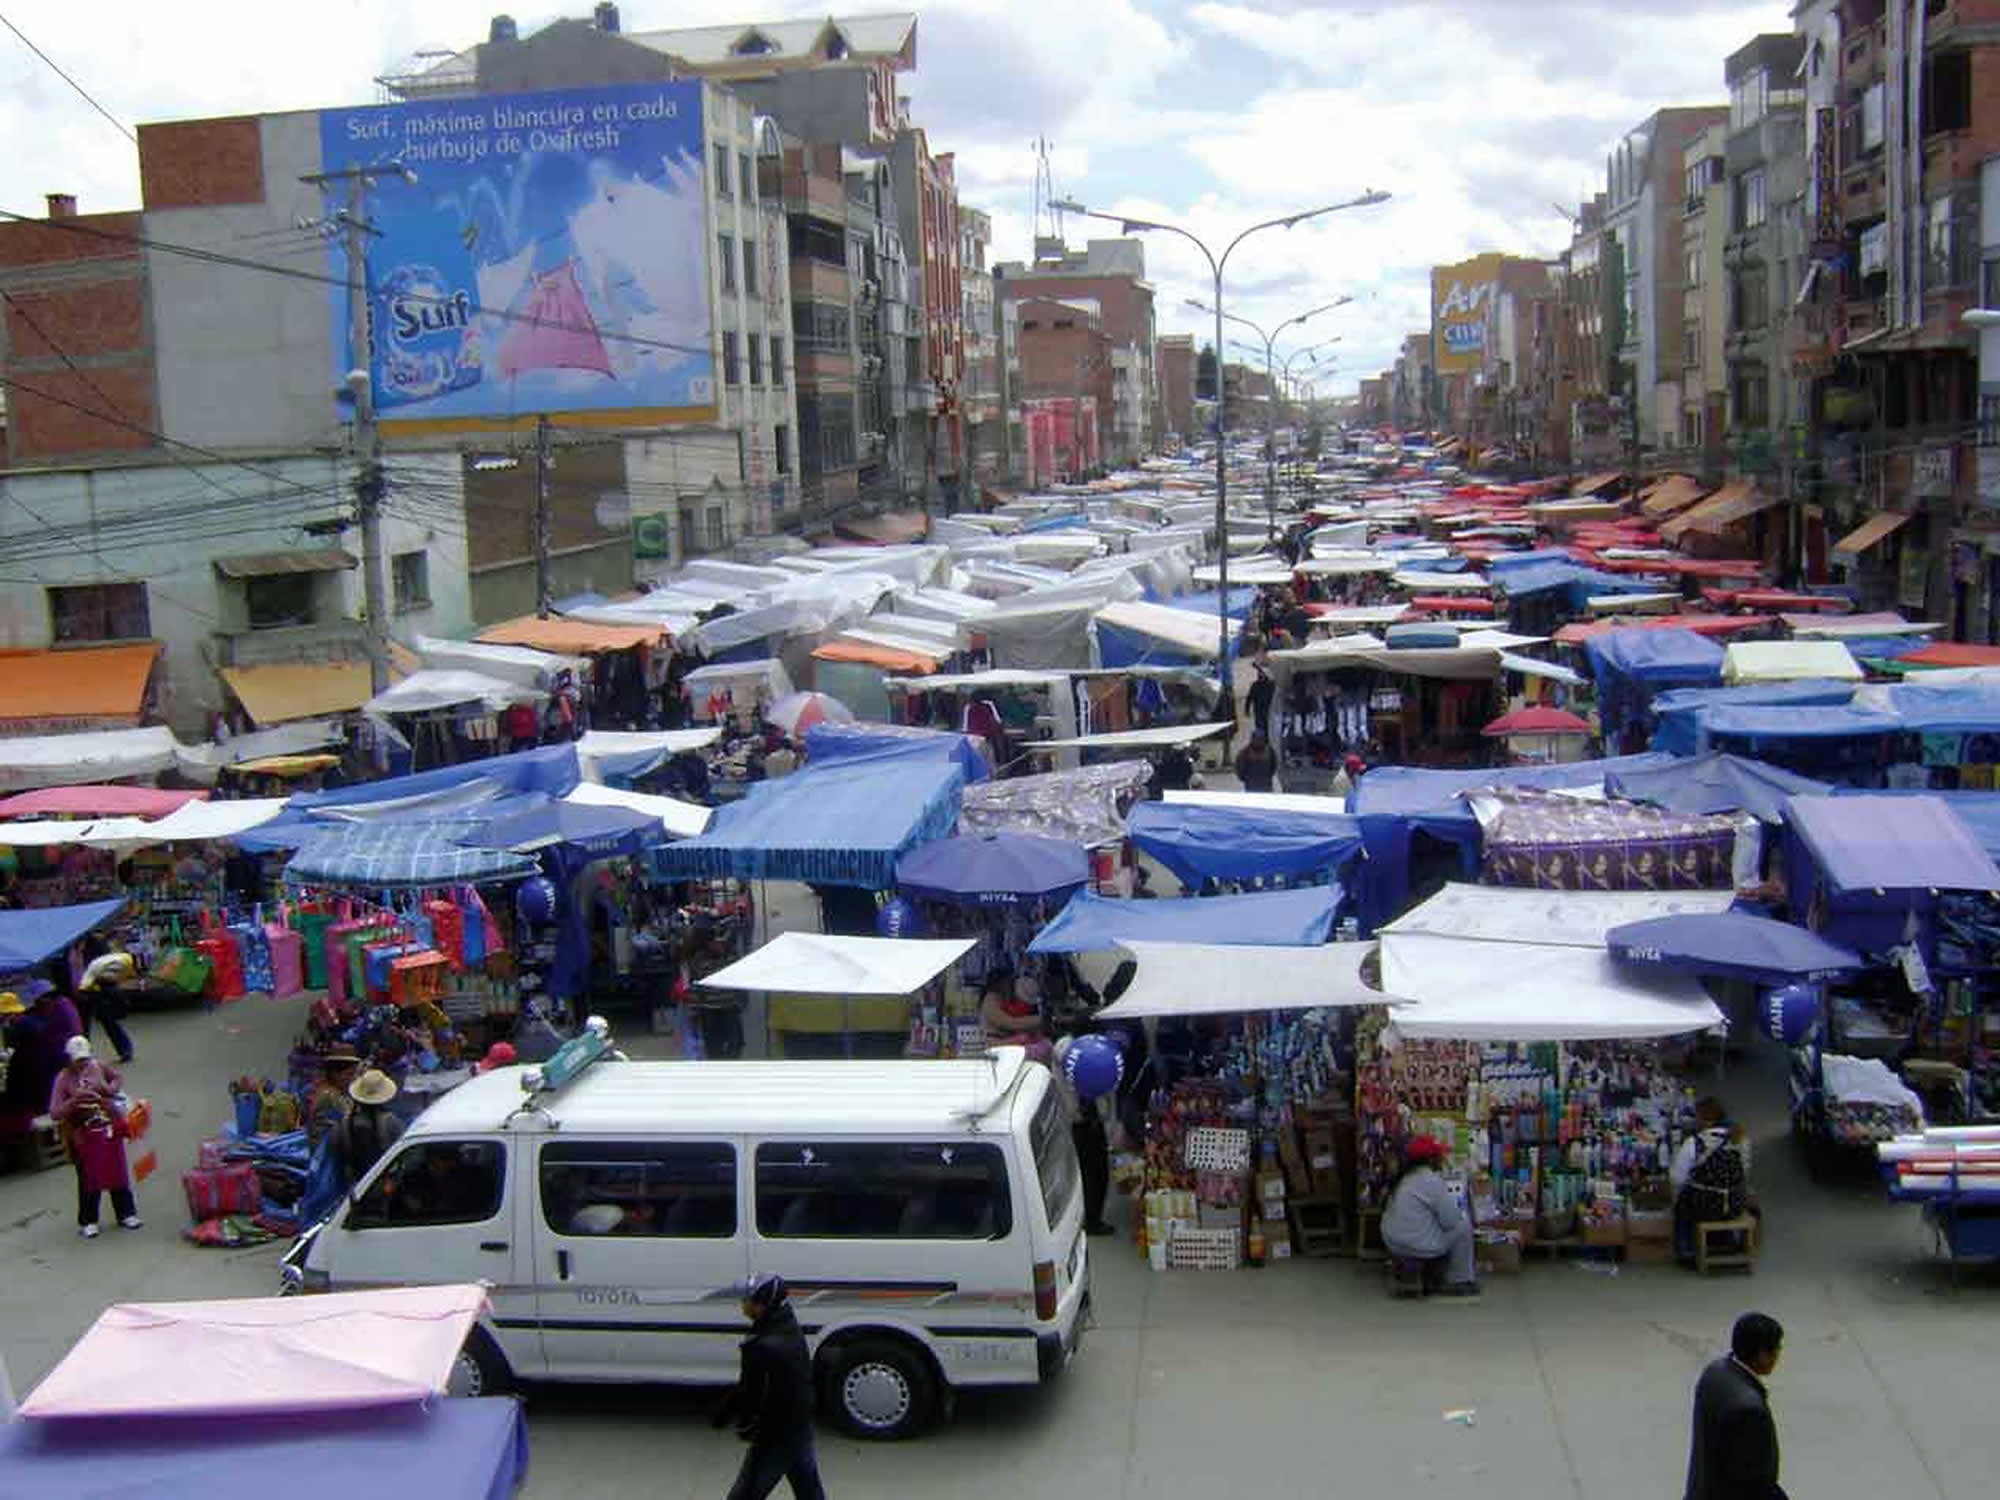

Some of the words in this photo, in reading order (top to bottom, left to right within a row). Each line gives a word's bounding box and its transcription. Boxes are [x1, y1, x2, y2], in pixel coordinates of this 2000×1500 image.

[405, 109, 485, 136] máxima
[493, 103, 584, 129] blancura
[592, 103, 619, 121] en
[627, 93, 678, 120] cada
[404, 135, 488, 164] burbuja
[495, 131, 521, 153] de
[530, 125, 620, 153] Oxifresh
[393, 290, 469, 339] Surf
[979, 893, 1018, 903] NIVEA
[1627, 946, 1661, 962] NIVEA
[576, 1285, 641, 1305] TOYOTA
